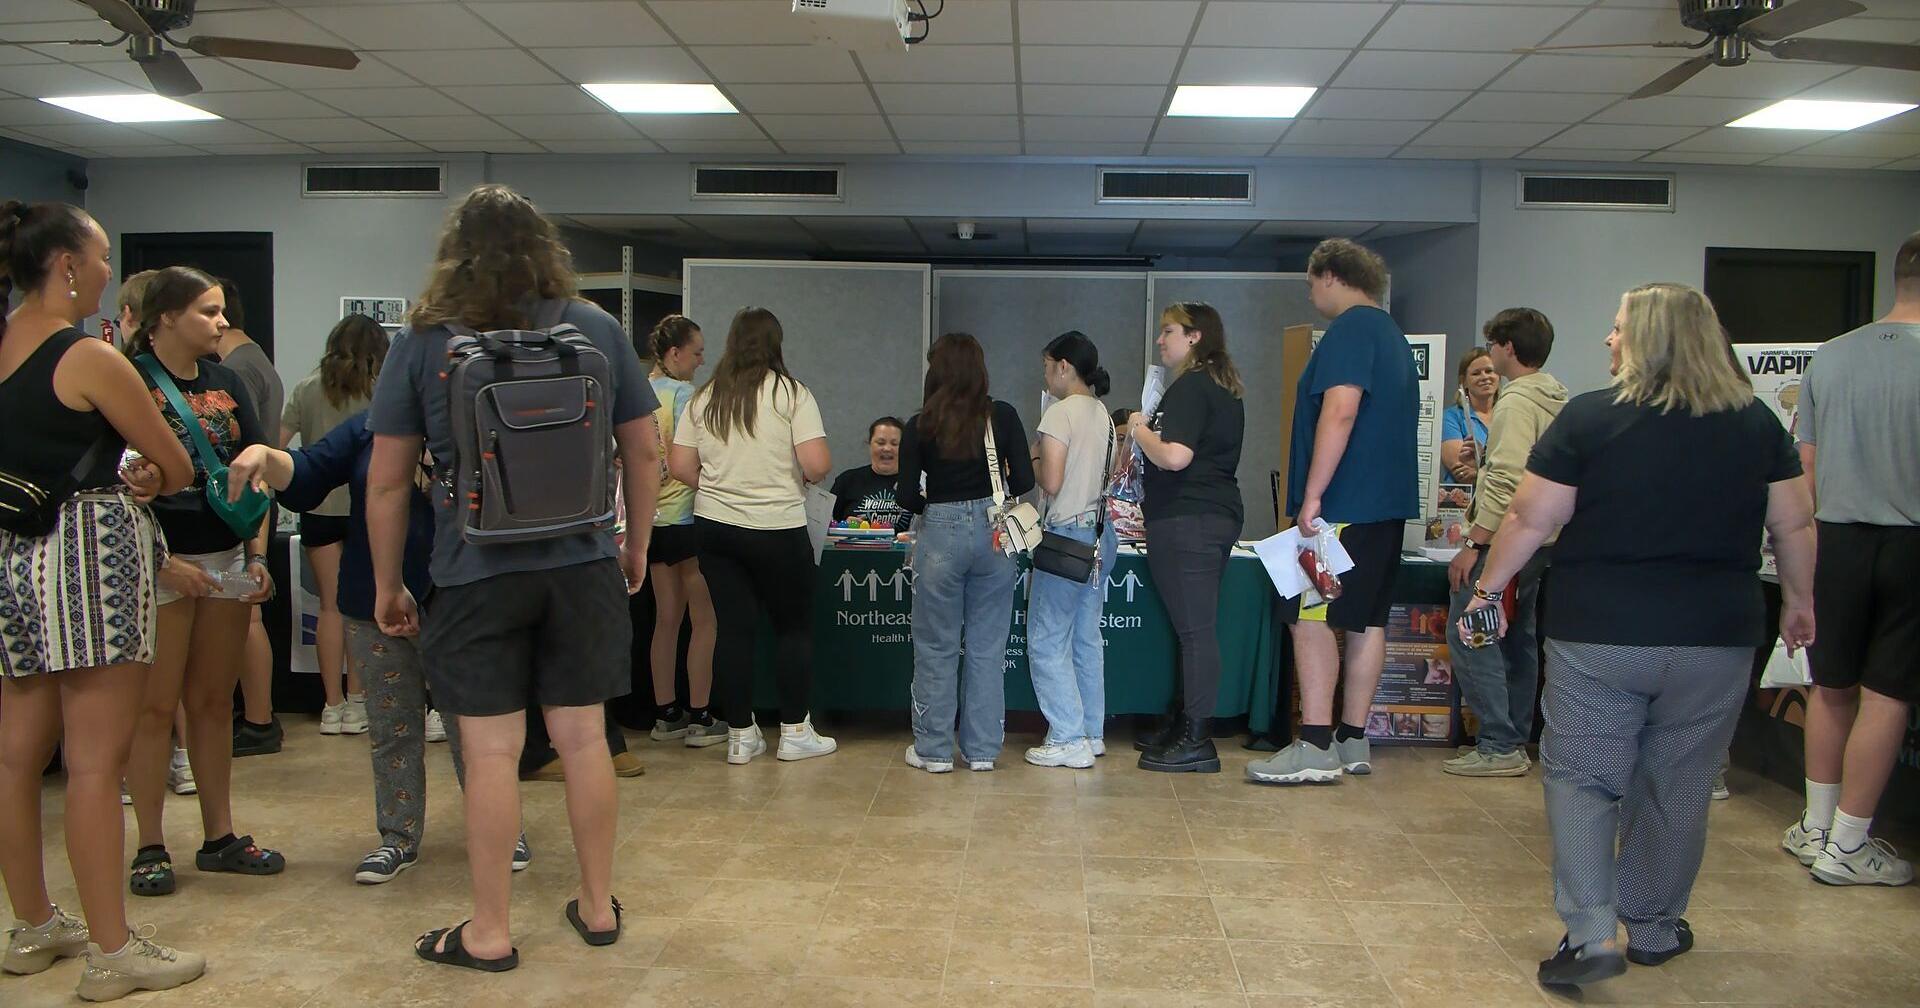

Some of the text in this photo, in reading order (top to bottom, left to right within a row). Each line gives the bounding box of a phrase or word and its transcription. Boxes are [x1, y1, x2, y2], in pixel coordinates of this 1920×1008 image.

[864, 499, 900, 510] Wellnes
[871, 512, 901, 523] Center
[872, 633, 904, 643] Health
